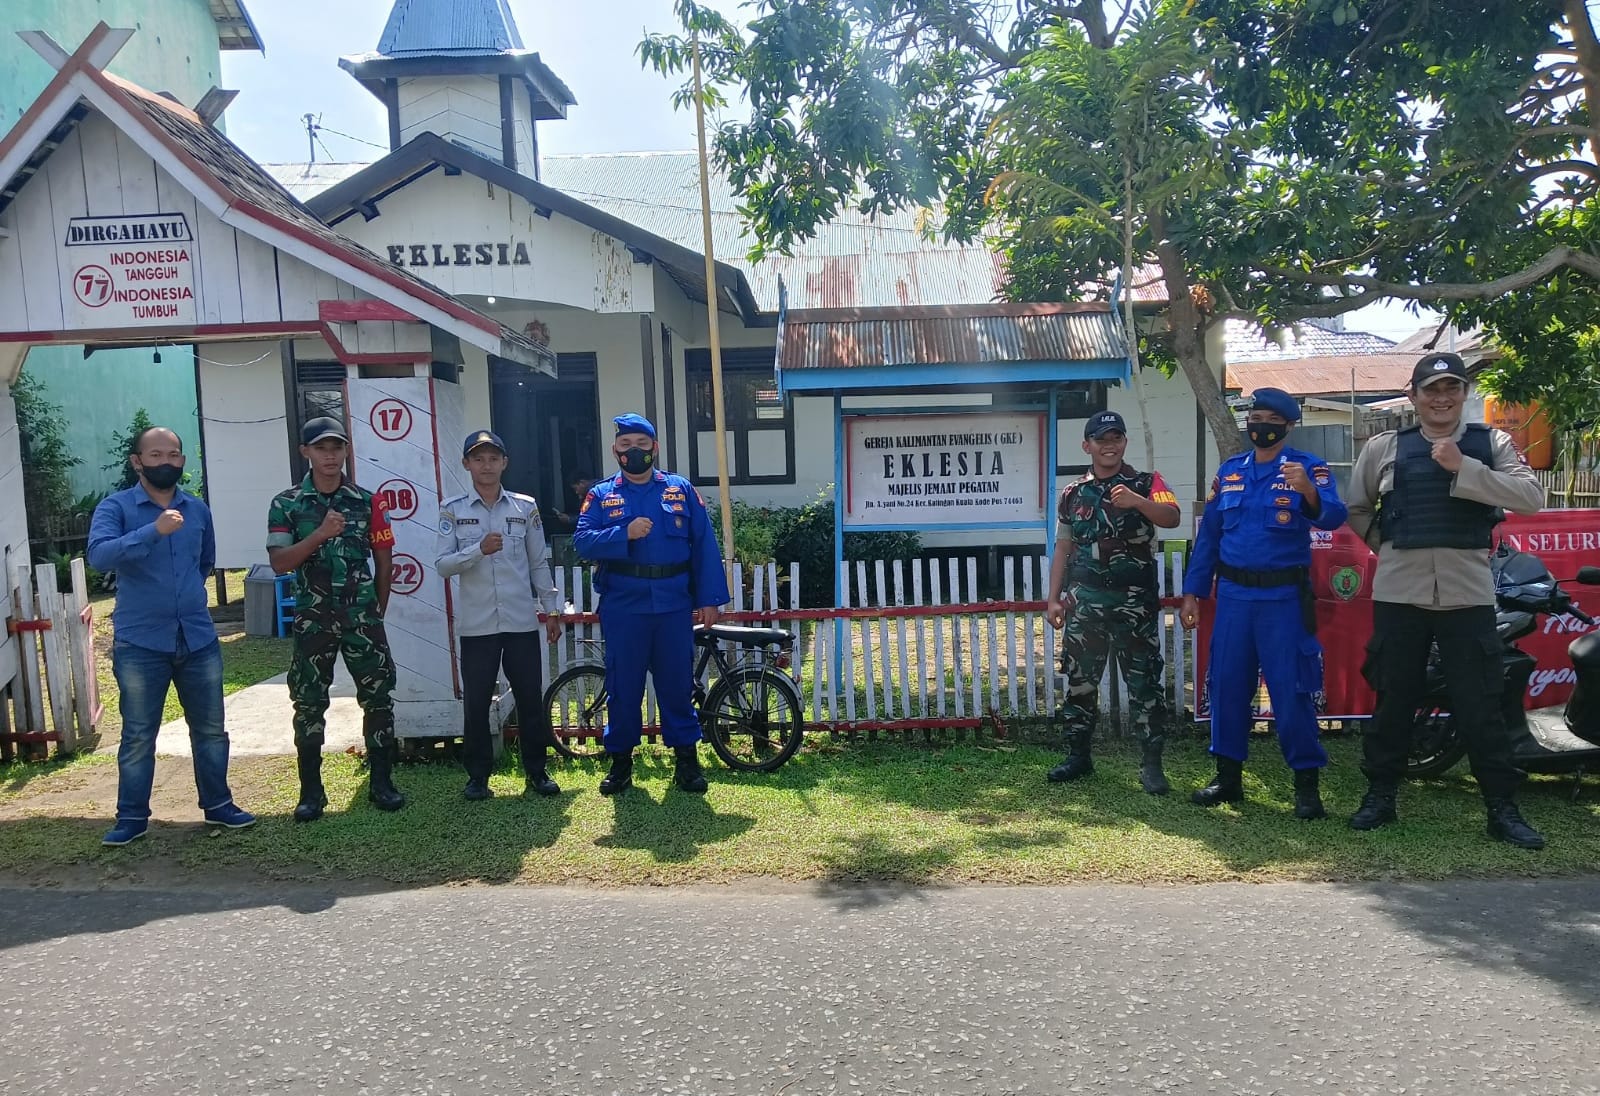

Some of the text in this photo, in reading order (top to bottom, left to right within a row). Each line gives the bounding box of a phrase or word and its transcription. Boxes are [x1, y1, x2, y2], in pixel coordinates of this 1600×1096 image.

[71, 222, 183, 242] DIRGAHAYU
[110, 249, 190, 265] INDONESIA
[387, 243, 531, 266] EKLESIA
[125, 267, 178, 281] TANGGUH
[79, 274, 109, 300] 77
[114, 287, 193, 302] INDONESIA
[132, 304, 178, 318] TUMBUH
[378, 408, 403, 431] 17
[864, 436, 894, 449] GEREJA
[896, 434, 947, 448] KALIMANTAN
[949, 433, 992, 446] EVANGELIS
[882, 450, 1004, 478] EKLESIA
[888, 481, 999, 496] MAJELIS JEMAAT PEGATAN
[382, 489, 413, 511] 08
[390, 563, 417, 585] 22
